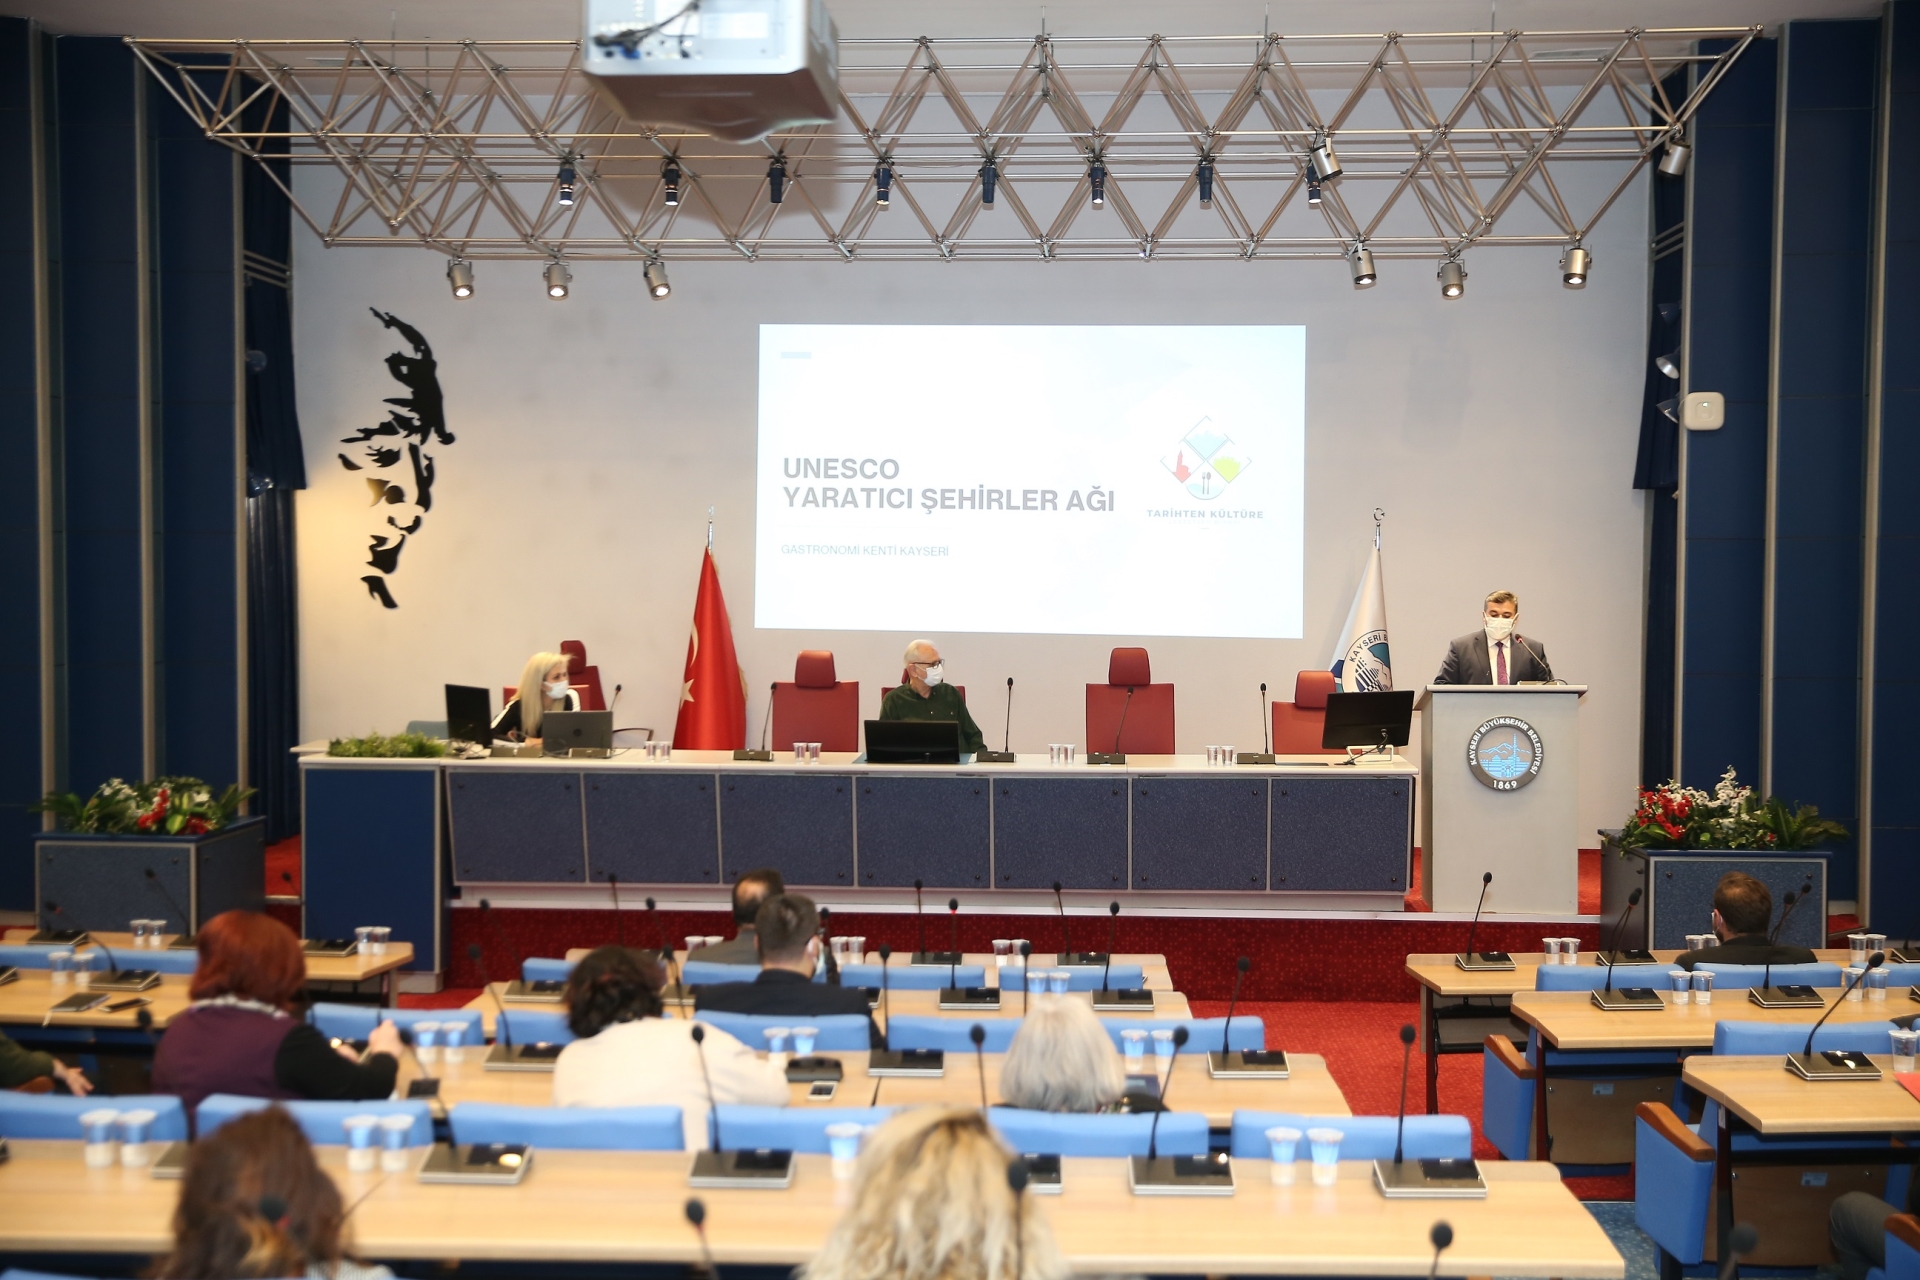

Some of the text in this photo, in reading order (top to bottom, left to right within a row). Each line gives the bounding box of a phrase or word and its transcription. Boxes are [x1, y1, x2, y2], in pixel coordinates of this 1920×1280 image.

[783, 457, 900, 480] UNESCO
[783, 484, 1115, 515] YARATICI ŞEHİRLER AĞI
[1146, 507, 1264, 519] TARİHTEN KÜLTÜRE
[781, 542, 949, 557] GASTRONOMİ KENTİ KAYSERİ
[1349, 633, 1381, 662] KAYSERİ
[1469, 731, 1481, 766] KAYSERİ
[1493, 780, 1517, 790] 1869
